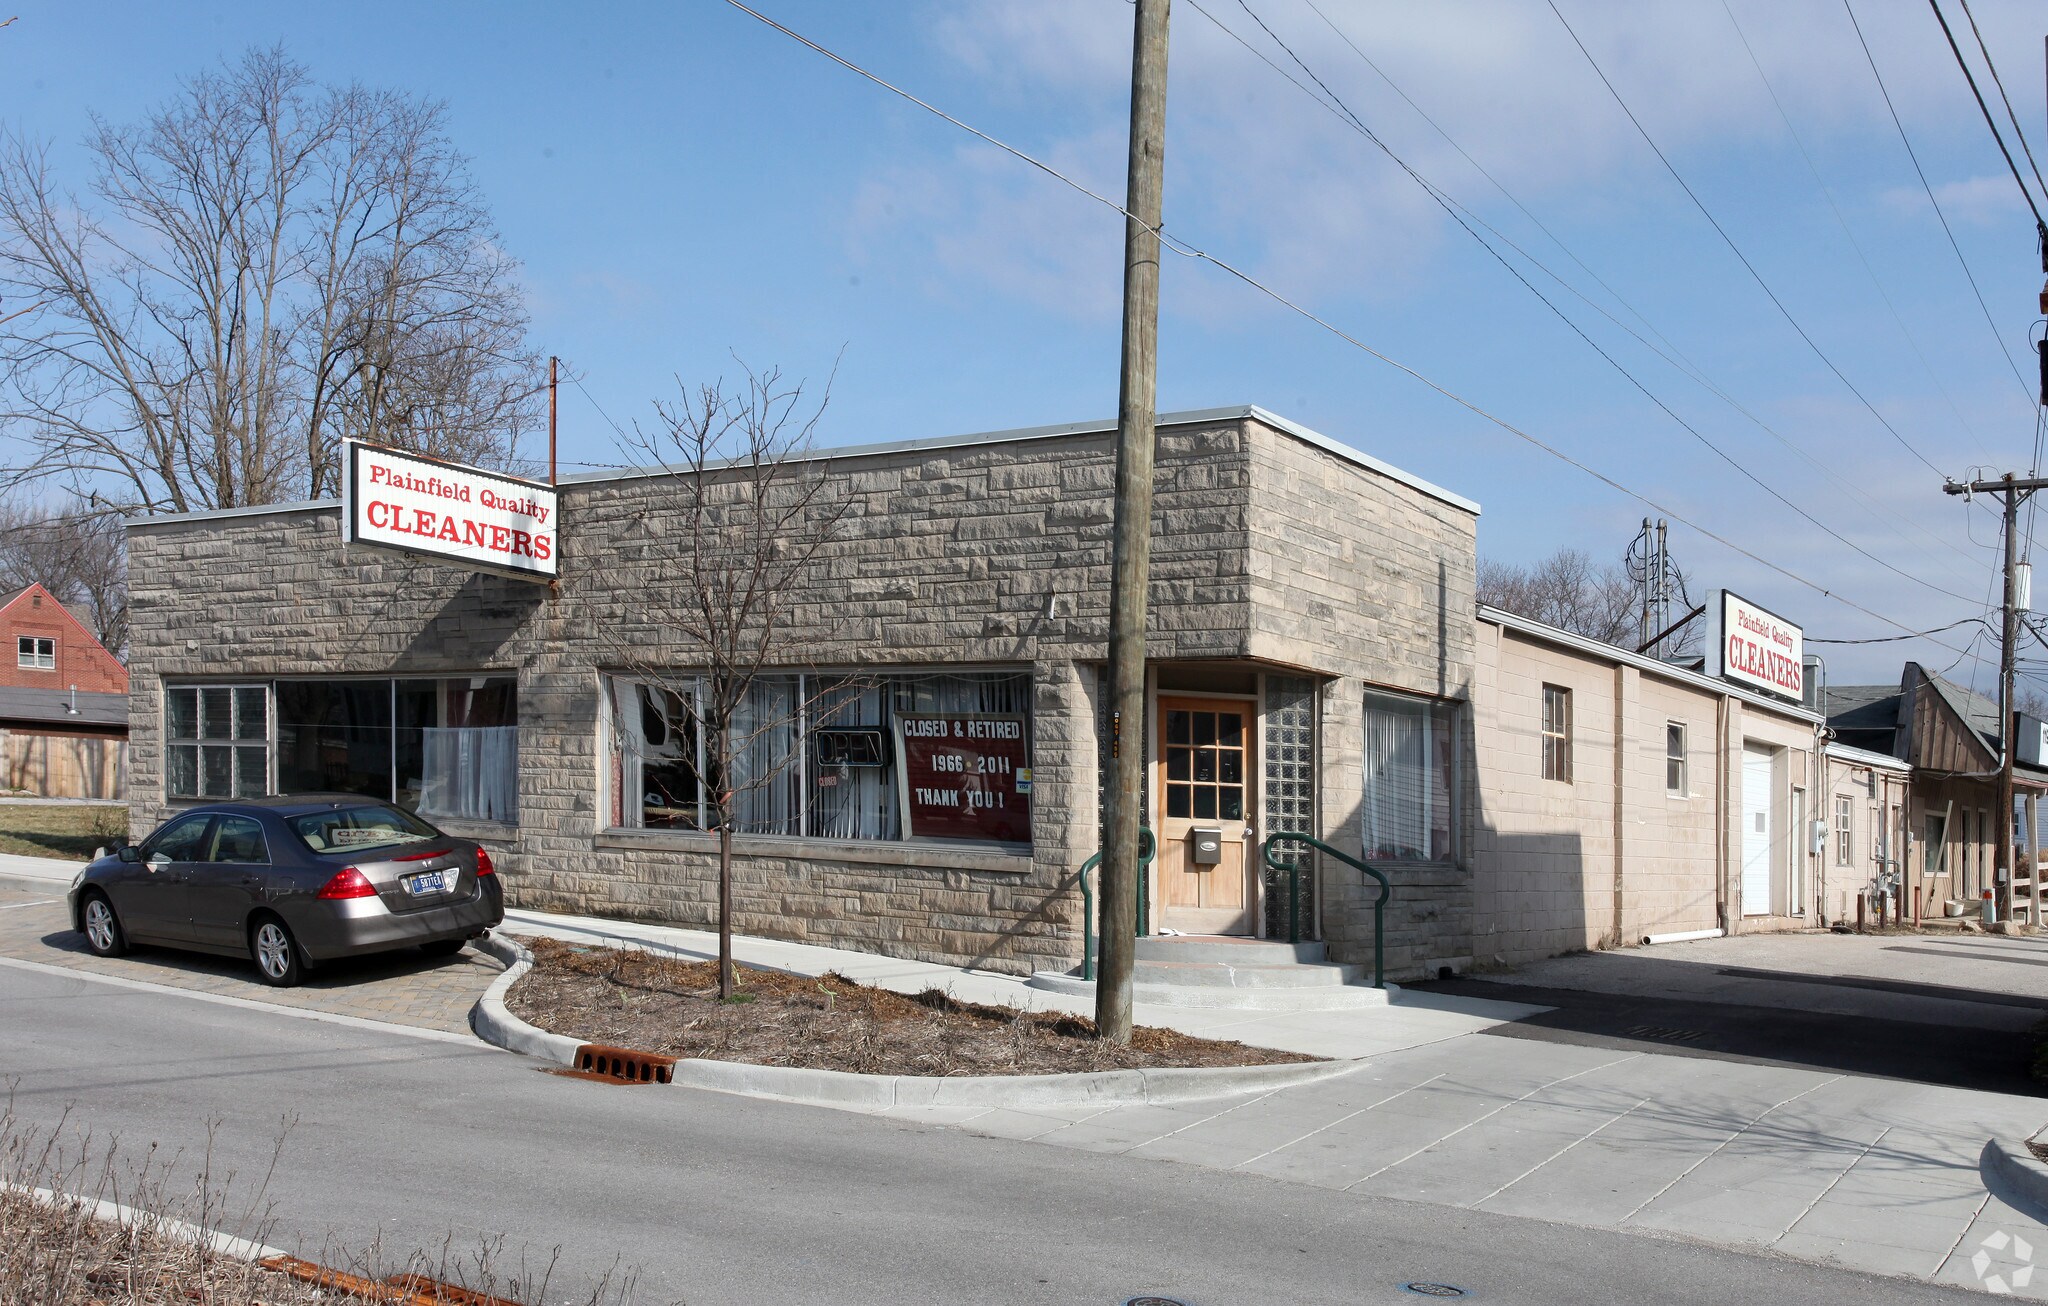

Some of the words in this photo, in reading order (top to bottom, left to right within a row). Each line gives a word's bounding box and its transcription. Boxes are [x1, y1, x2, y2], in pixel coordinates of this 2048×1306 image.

[370, 464, 471, 503] Plainfield
[480, 489, 550, 524] Quality
[367, 500, 551, 560] CLEANERS
[1738, 609, 1769, 638] Plainfield
[1772, 625, 1794, 653] Quality
[1729, 634, 1801, 692] CLEANERS
[904, 720, 948, 737] CLOSED
[954, 720, 964, 737] &
[967, 721, 1020, 739] RETIRED
[820, 733, 880, 763] OPEN
[932, 754, 963, 772] 1966
[977, 756, 1010, 774] 2011
[818, 776, 838, 787] CLOSED
[915, 787, 959, 807] THANK
[966, 790, 993, 808] YOU
[998, 791, 1004, 809] !
